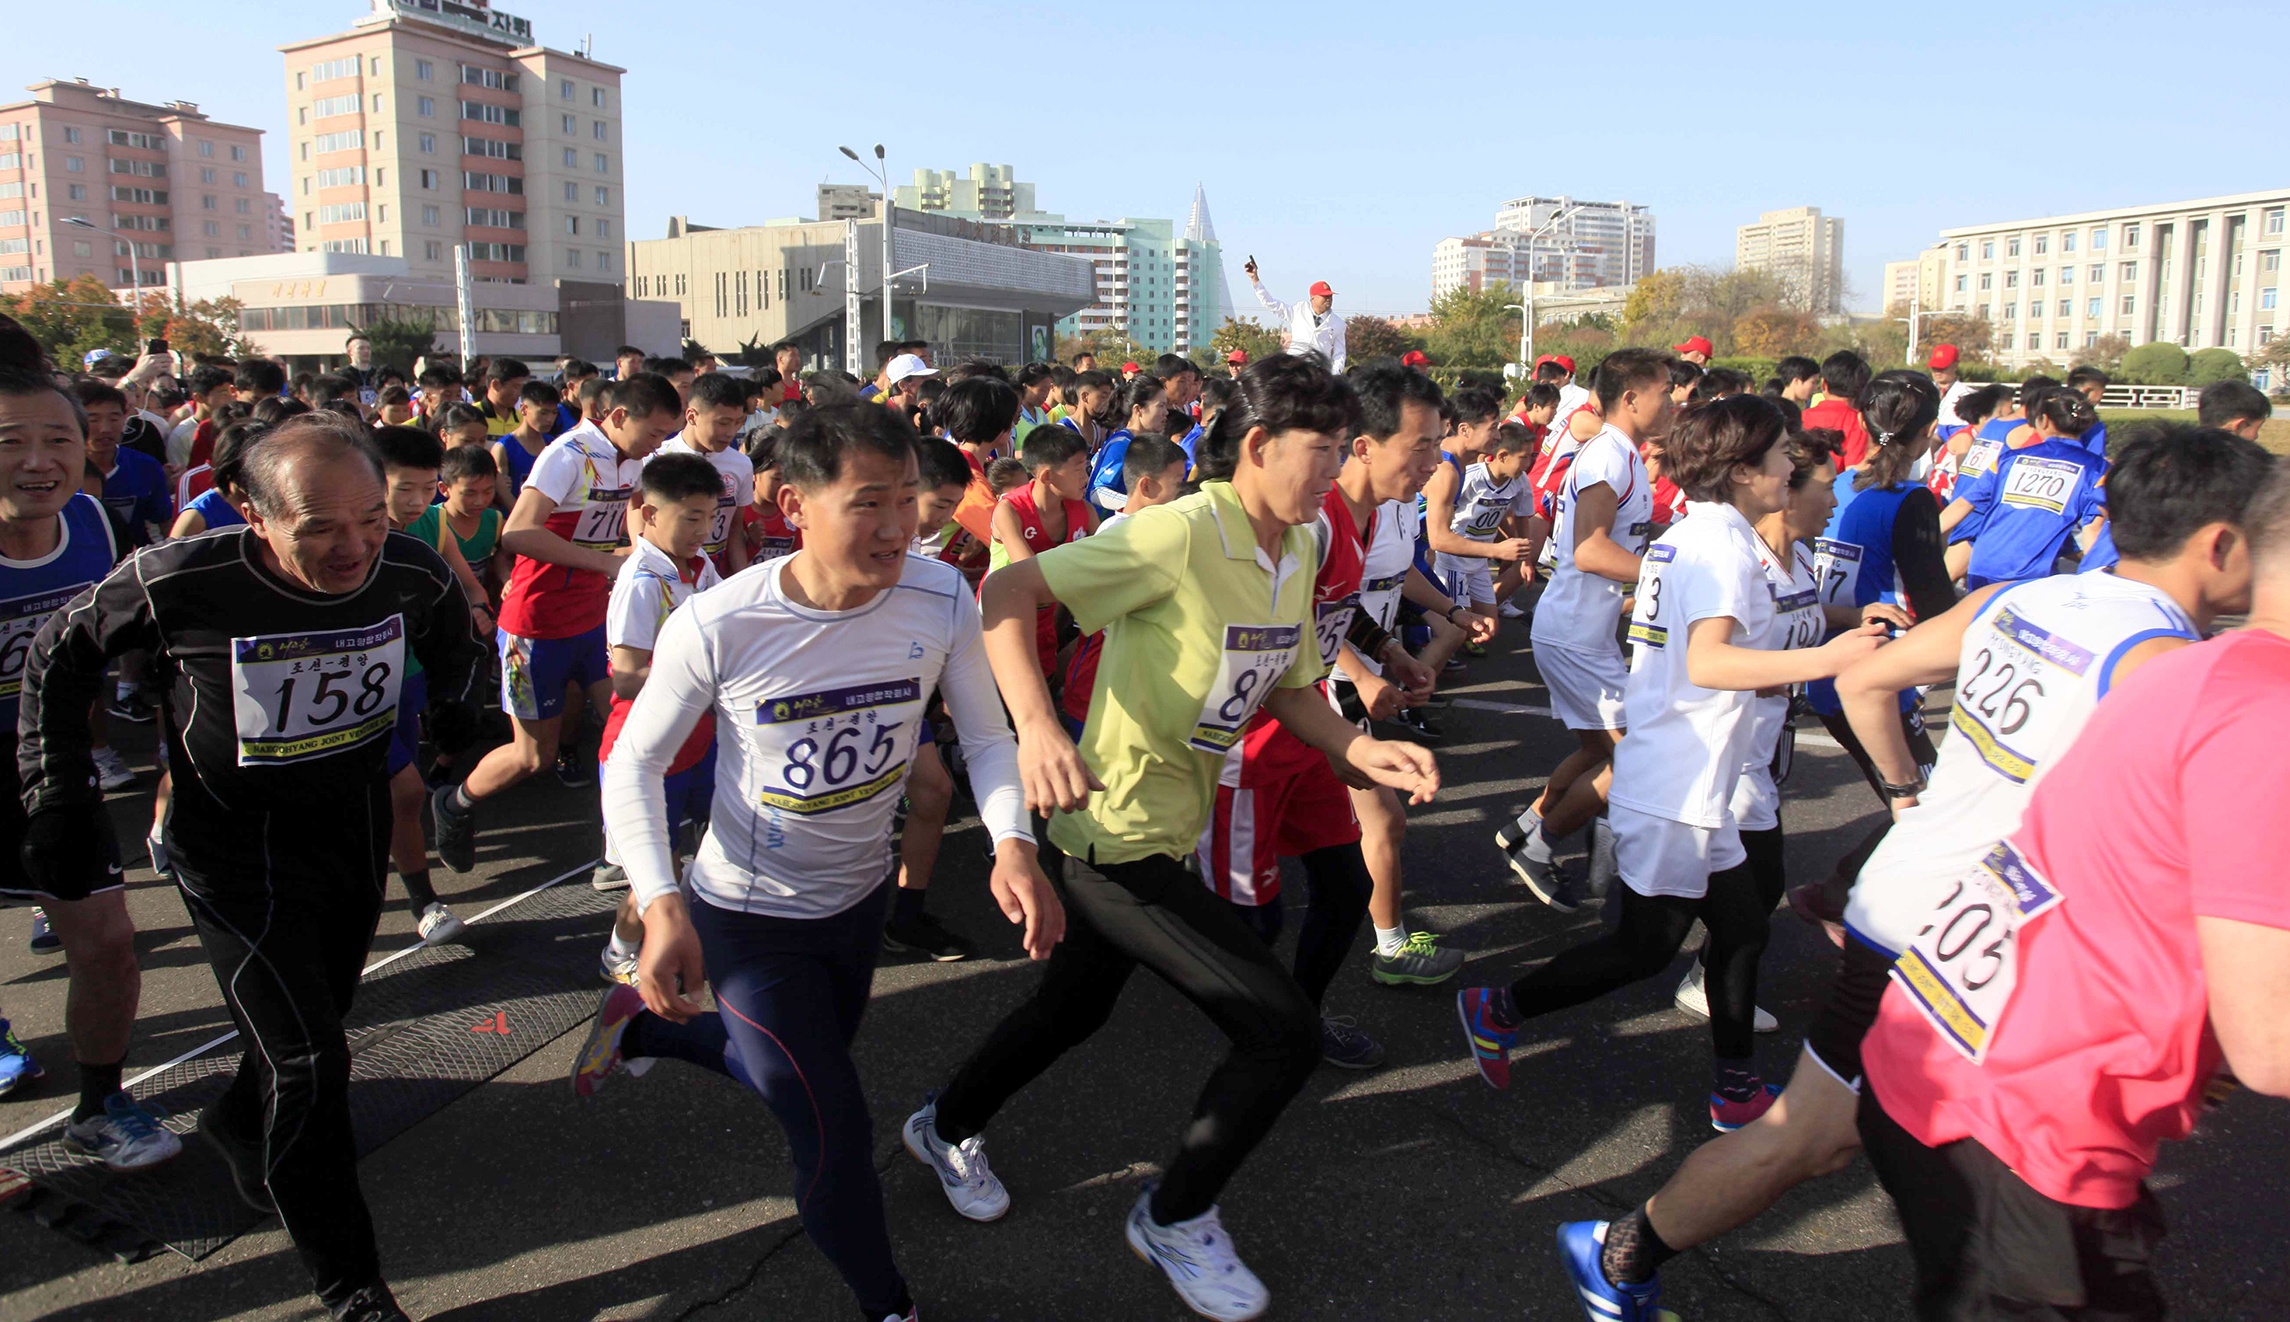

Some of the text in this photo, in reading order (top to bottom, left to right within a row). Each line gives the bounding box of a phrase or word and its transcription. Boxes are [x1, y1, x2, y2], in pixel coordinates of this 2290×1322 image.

[2014, 472, 2065, 497] 1270
[274, 661, 391, 733] 158
[1962, 648, 2046, 735] 226
[253, 739, 318, 754] NAEGOHYANG
[320, 734, 346, 746] JOINT
[782, 721, 904, 790] 865
